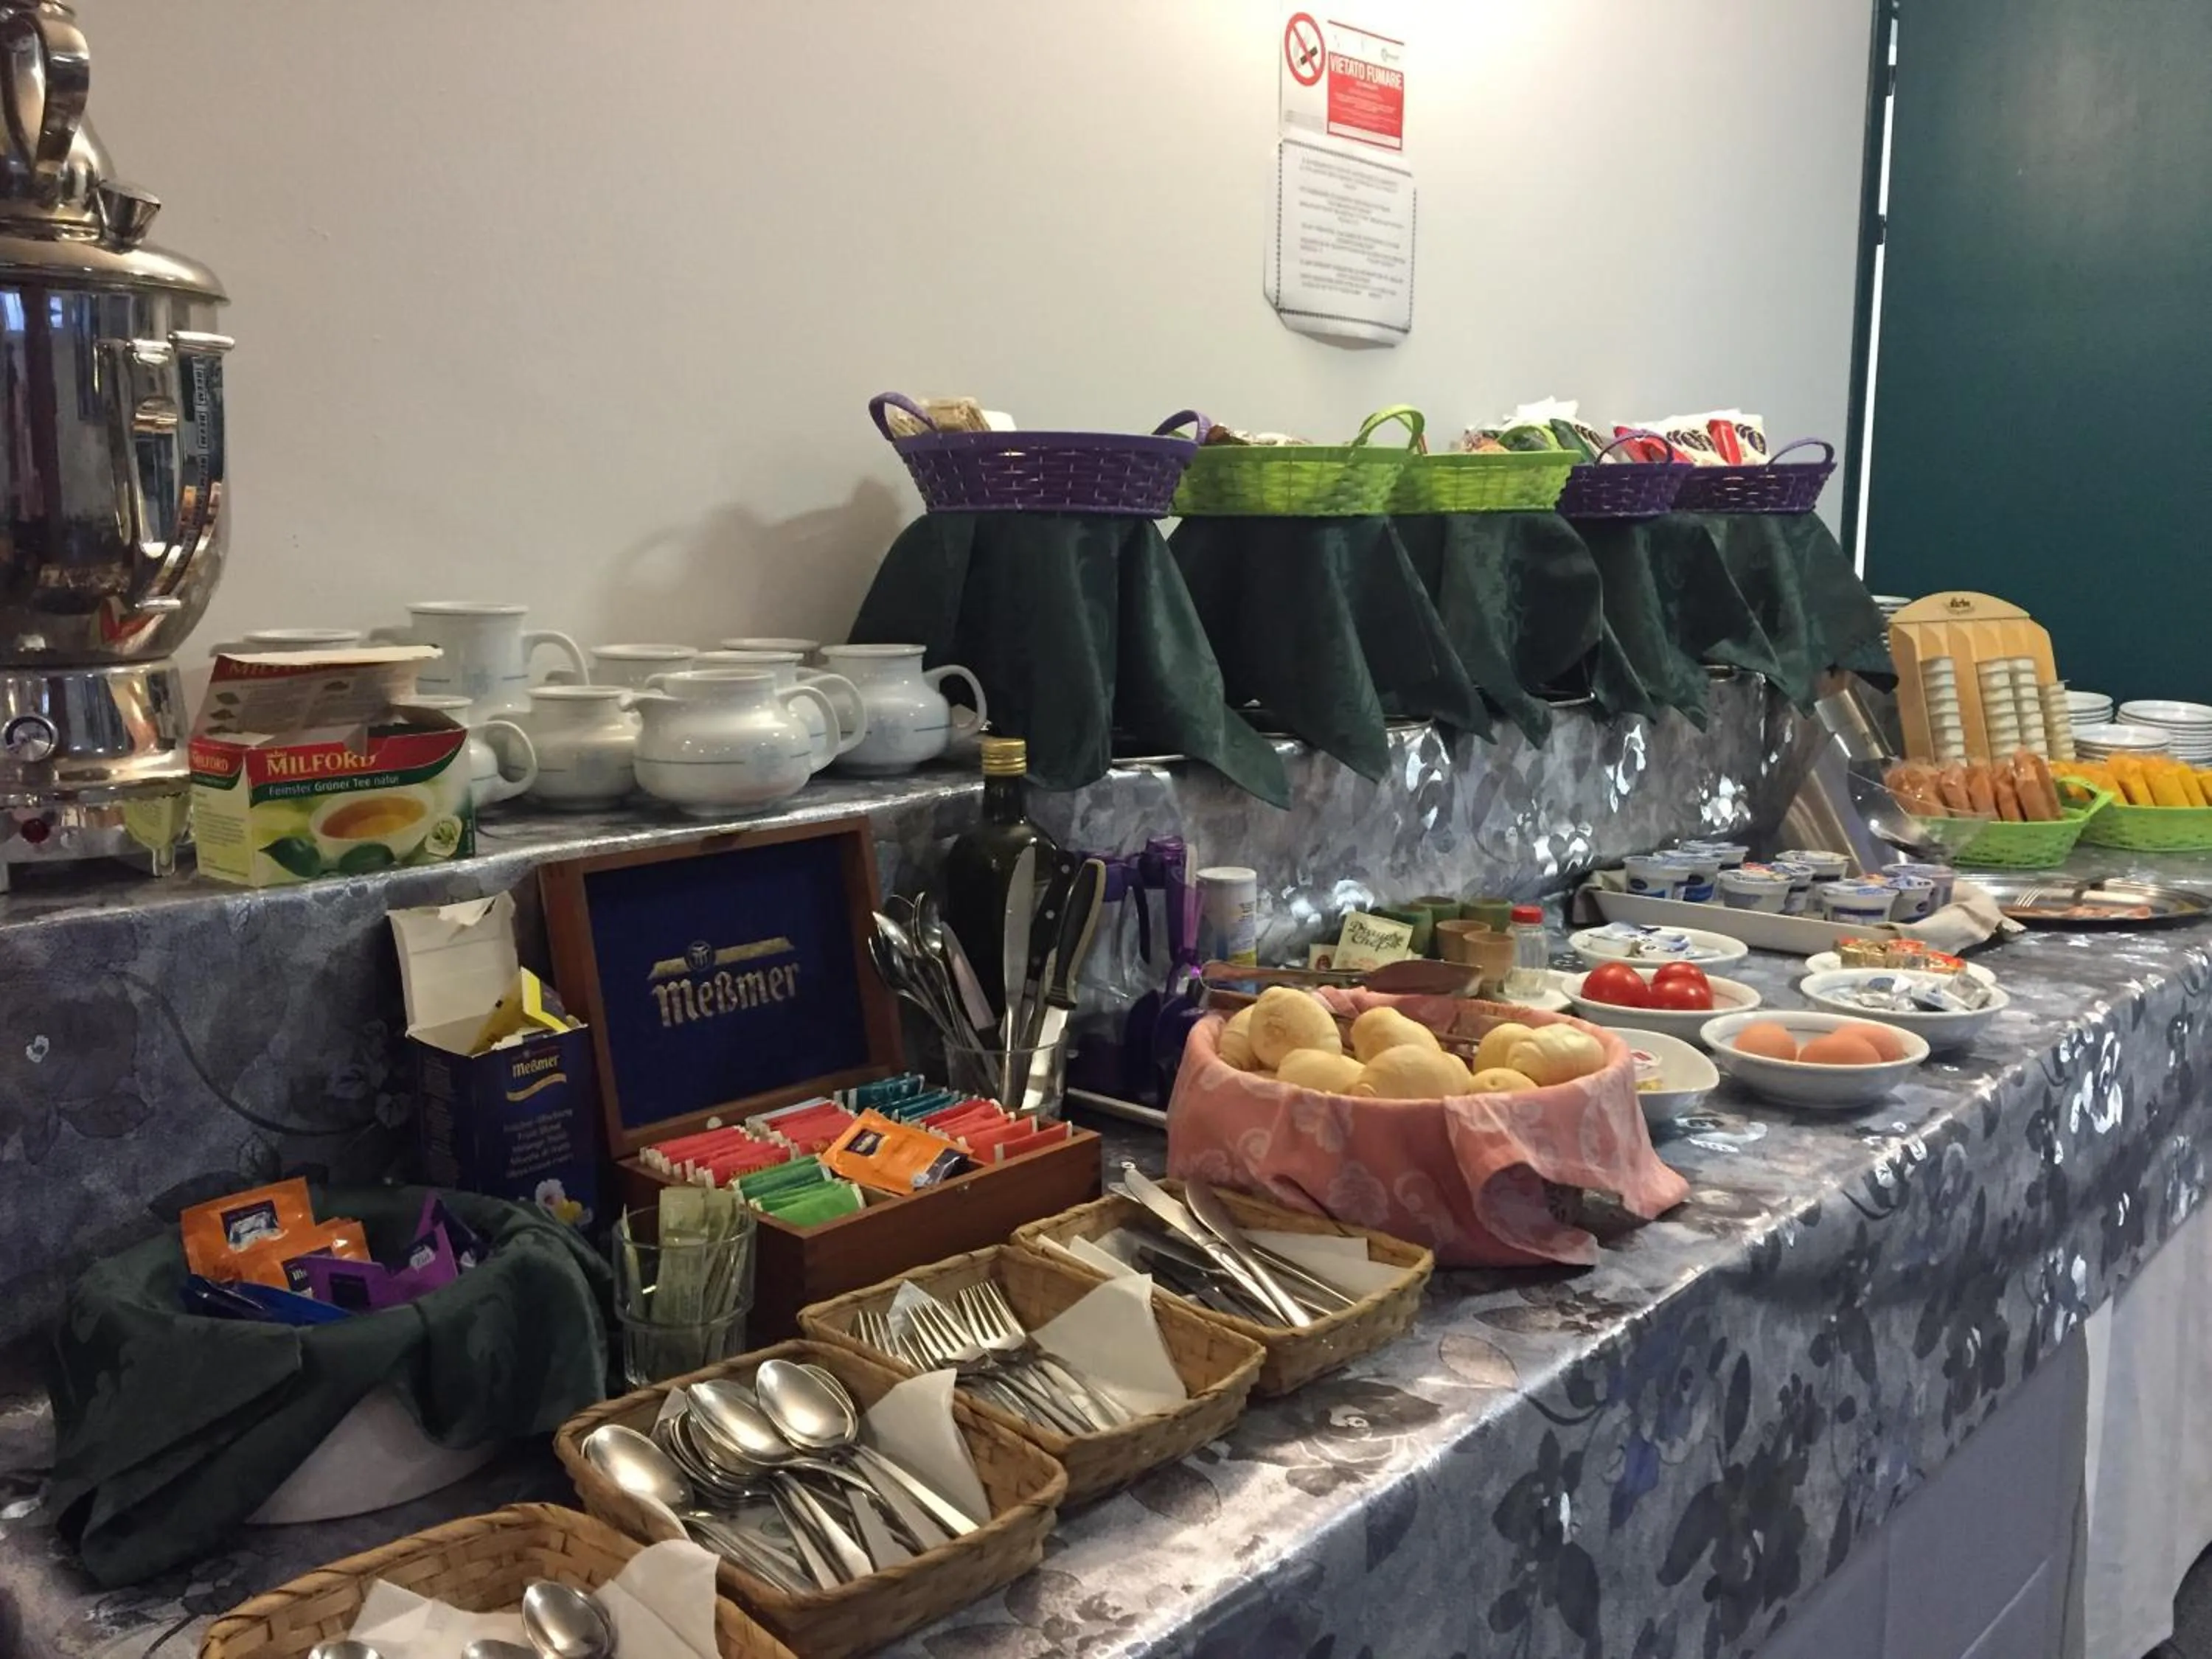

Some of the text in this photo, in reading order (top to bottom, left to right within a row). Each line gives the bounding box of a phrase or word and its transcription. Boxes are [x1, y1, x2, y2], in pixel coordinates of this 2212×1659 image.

[1366, 64, 1402, 89] FUMARE
[353, 776, 371, 788] Tee
[650, 961, 801, 1027] Meßmer
[512, 1054, 560, 1079] Meßmer
